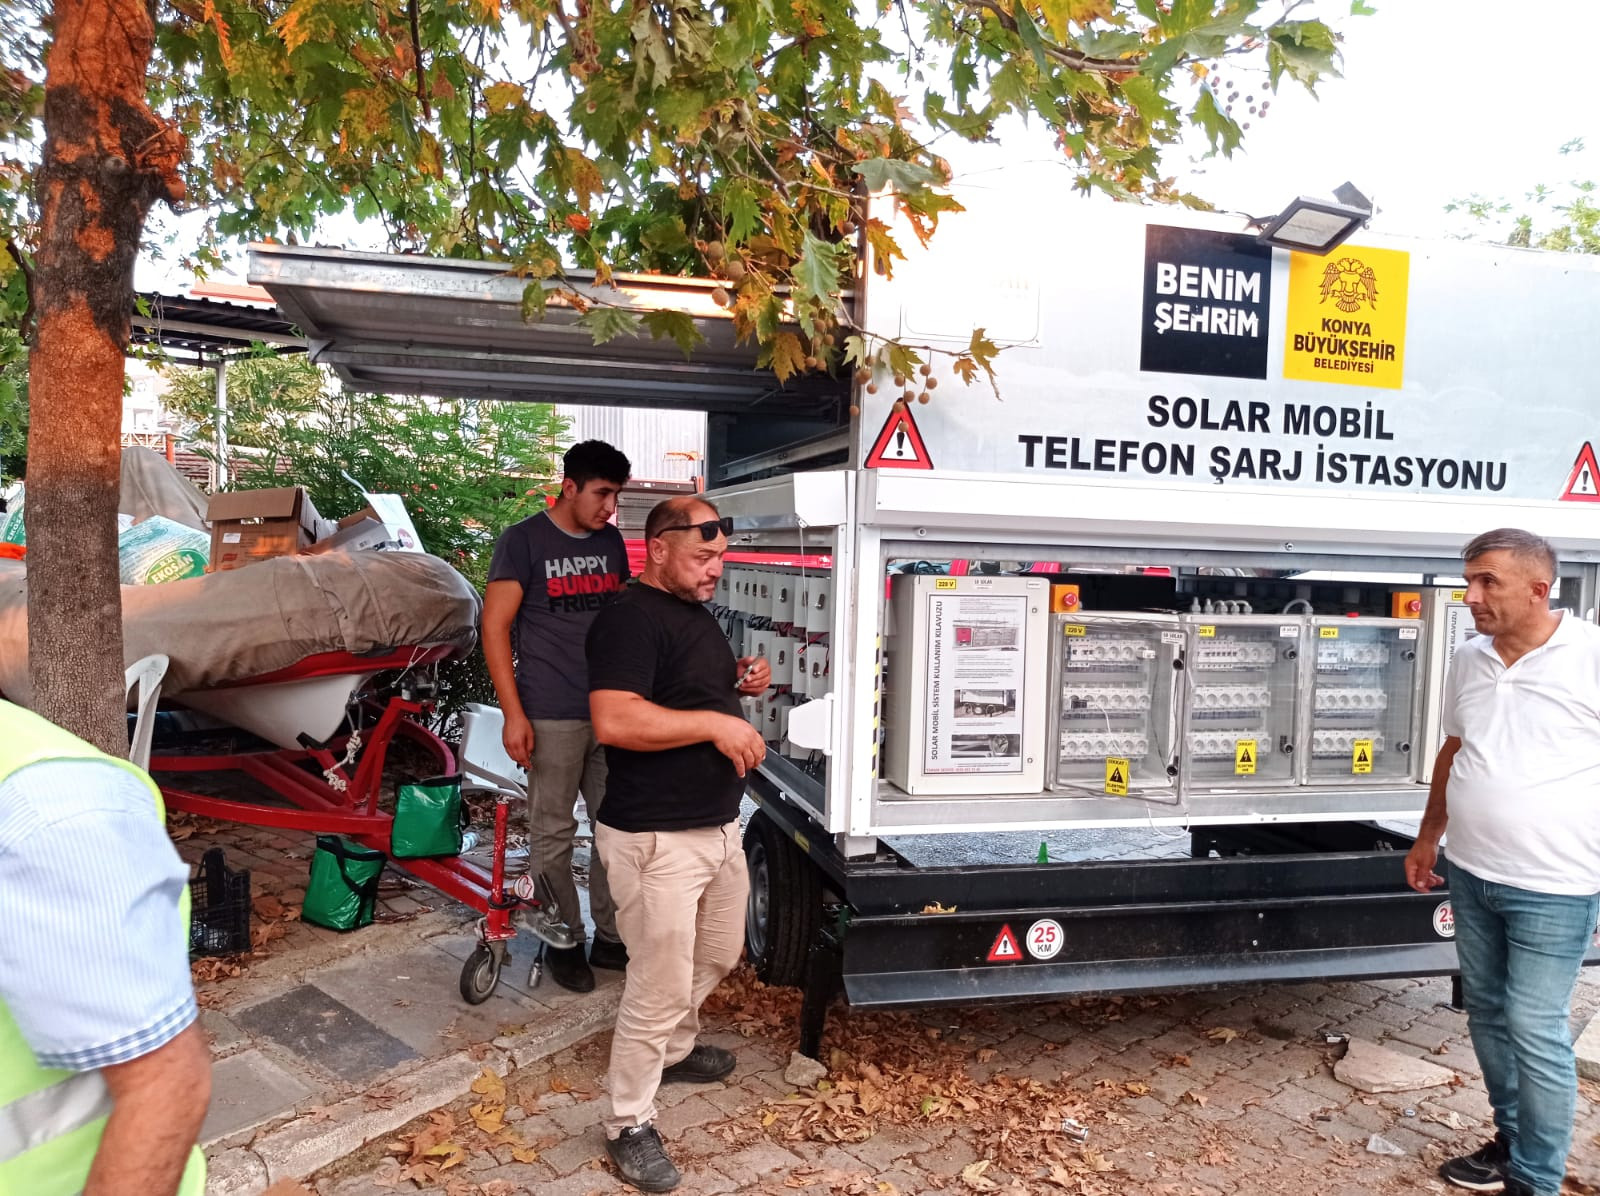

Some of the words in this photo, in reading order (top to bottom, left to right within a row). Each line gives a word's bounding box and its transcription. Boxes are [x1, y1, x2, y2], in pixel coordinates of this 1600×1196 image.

[1321, 318, 1371, 337] KONYA
[1293, 331, 1395, 361] BÜYÜKŞEHİR
[1313, 357, 1374, 373] BELEDİYESİ
[1147, 395, 1270, 433] SOLAR
[1283, 400, 1394, 441] MOBİL
[1018, 434, 1195, 476] TELEFON
[1210, 446, 1302, 485] ŞARJ
[1314, 443, 1507, 492] İSTASYONU
[545, 555, 608, 579] HAPPY
[935, 600, 943, 638] KILAVUZU
[933, 640, 941, 679] KULLANIM
[932, 680, 940, 708] SİSTEM
[931, 709, 939, 734] MOBİL
[931, 735, 939, 760] SOLAR
[1034, 927, 1055, 943] 25
[1037, 944, 1052, 952] KM
